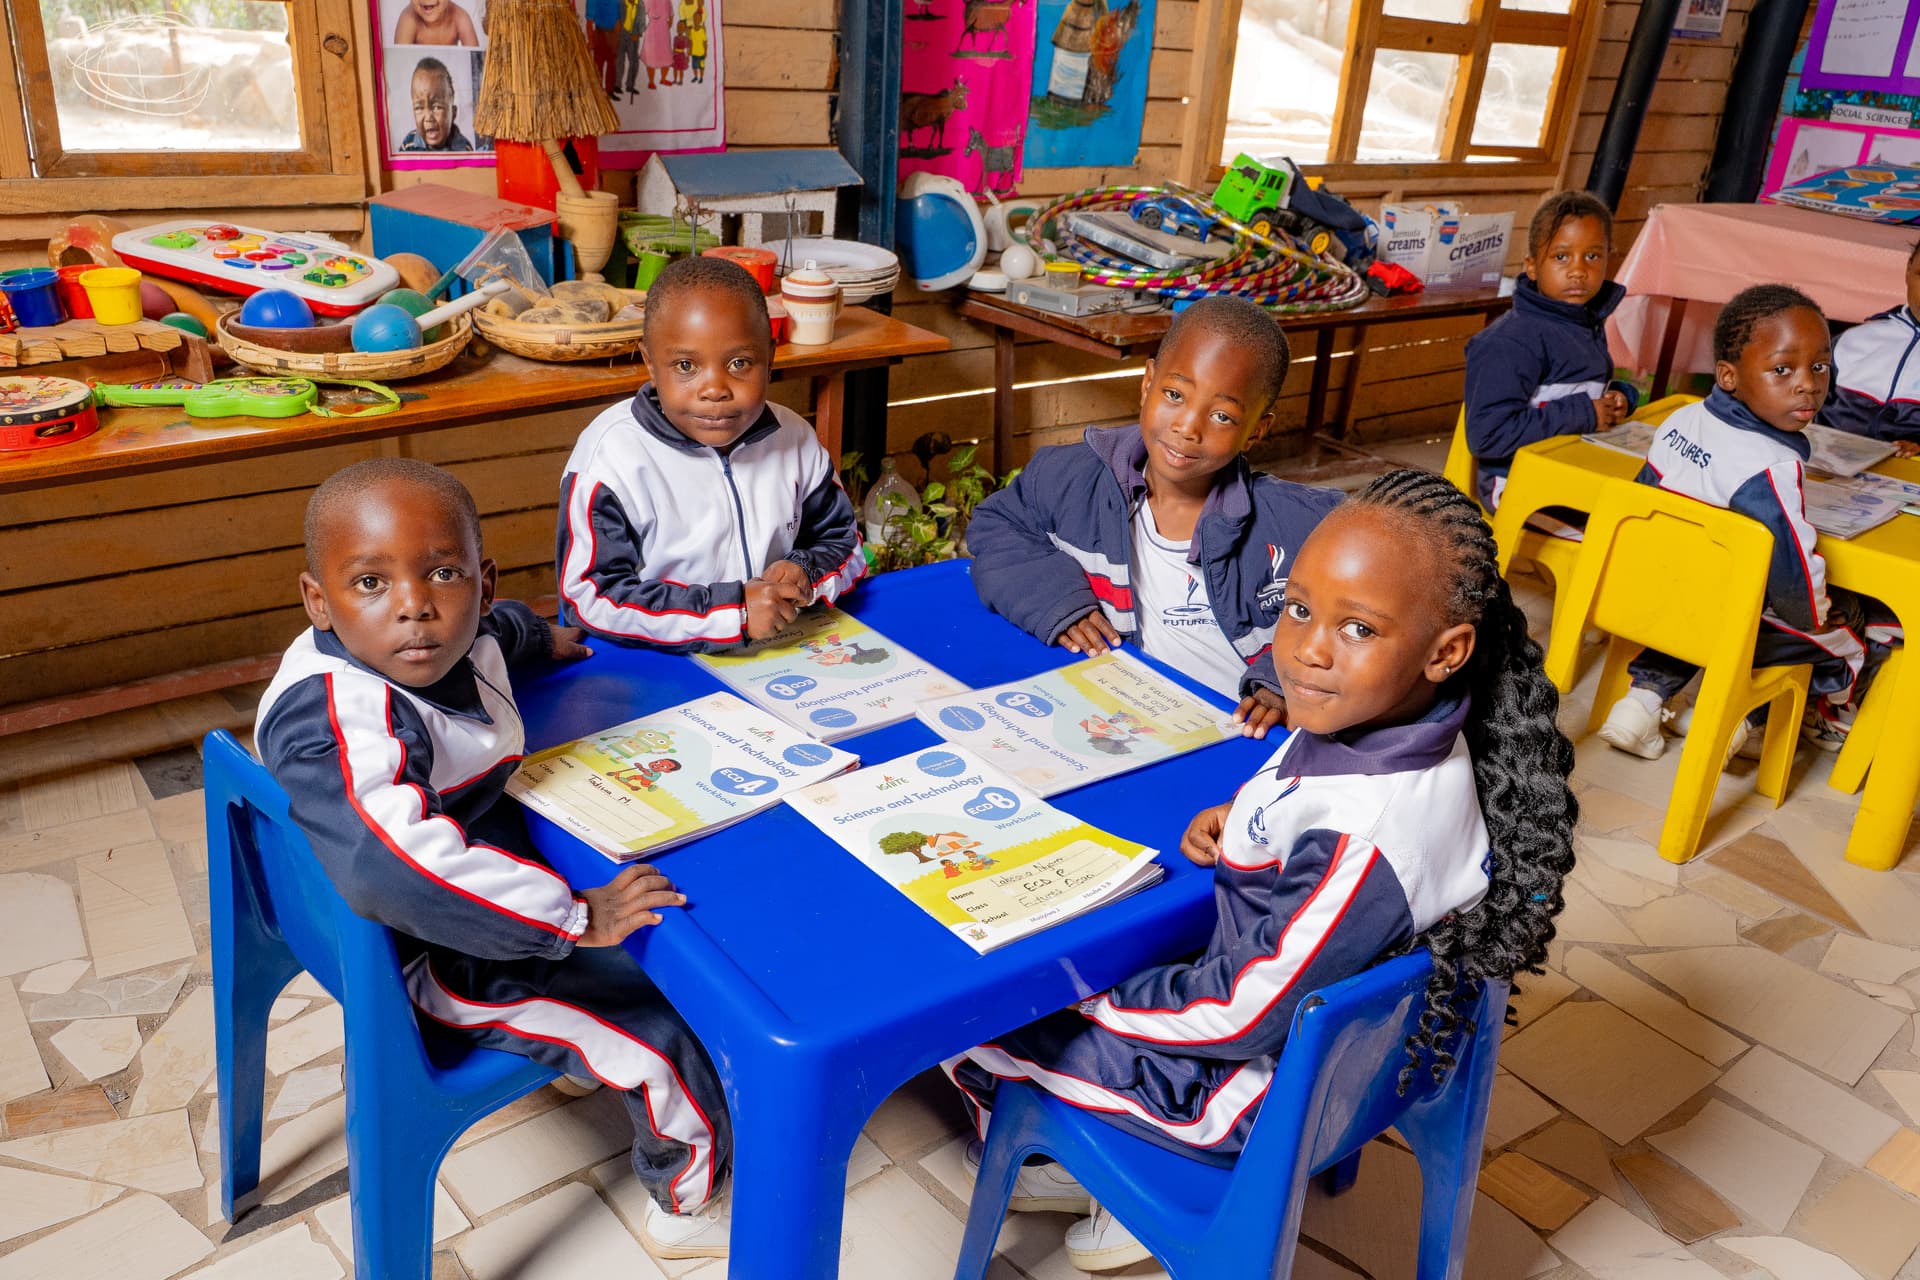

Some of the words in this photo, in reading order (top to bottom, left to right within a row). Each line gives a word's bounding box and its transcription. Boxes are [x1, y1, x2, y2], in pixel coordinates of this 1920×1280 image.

[1831, 105, 1862, 120] SOCIAL
[1866, 112, 1910, 125] SCIENCES
[1387, 238, 1425, 252] creams
[1449, 233, 1504, 261] creams
[1662, 428, 1712, 469] FUTURES
[1260, 593, 1286, 611] FUTU
[1163, 618, 1218, 627] FUTURES
[883, 668, 928, 686] Science
[859, 681, 883, 694] and
[795, 688, 860, 711] Technology
[977, 701, 1031, 741] Technology
[678, 708, 717, 732] Science
[716, 730, 742, 745] and
[739, 740, 800, 778] Technology
[1029, 737, 1050, 751] and
[1050, 749, 1089, 772] Science
[719, 768, 745, 784] ECD
[734, 778, 769, 793] A
[876, 776, 910, 792] IGNITE
[696, 781, 737, 808] Workbook
[833, 805, 886, 825] Science
[887, 795, 915, 809] and
[914, 774, 985, 802] Technology
[967, 802, 994, 816] ECD
[983, 791, 1016, 809] B
[994, 810, 1043, 831] Workbook
[951, 889, 975, 902] Name
[966, 902, 989, 914] Class
[980, 910, 1009, 926] School
